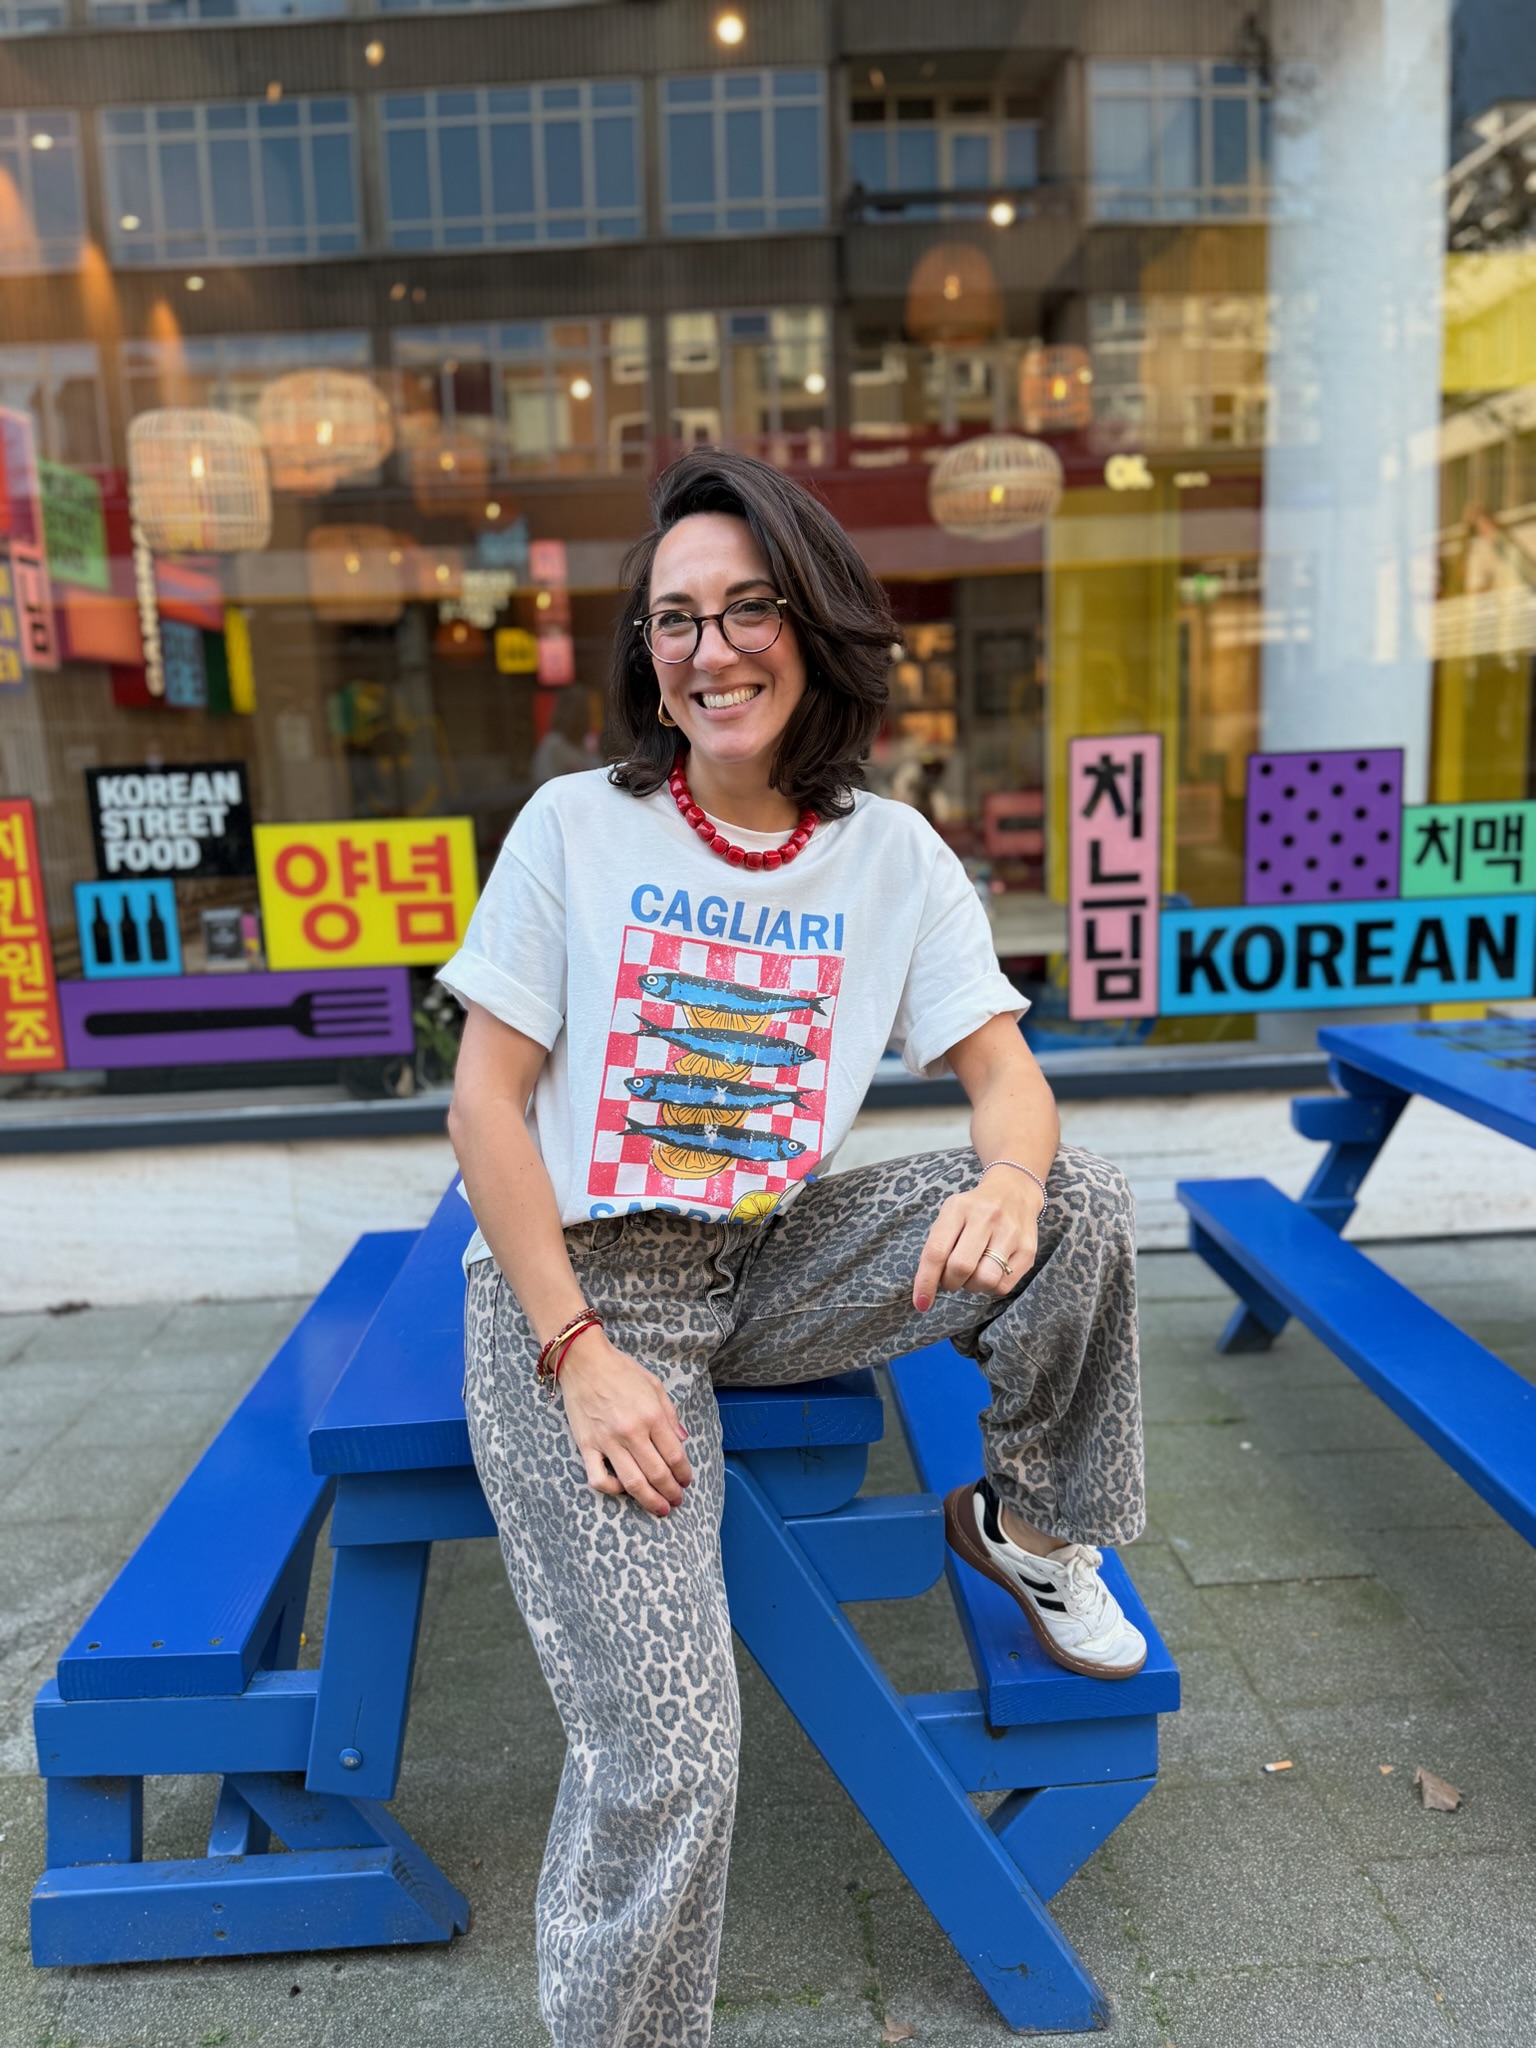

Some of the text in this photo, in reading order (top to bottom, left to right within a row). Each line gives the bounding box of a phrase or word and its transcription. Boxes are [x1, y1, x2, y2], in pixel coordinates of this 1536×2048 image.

[98, 772, 240, 806] KOREAN
[101, 806, 229, 839] STREET
[106, 839, 200, 872] FOOD
[1082, 752, 1148, 1001] 치느님
[1415, 814, 1525, 884] 치맥
[274, 834, 456, 952] 양념
[631, 883, 845, 951] CAGLIARI
[1177, 914, 1518, 996] KOREAN
